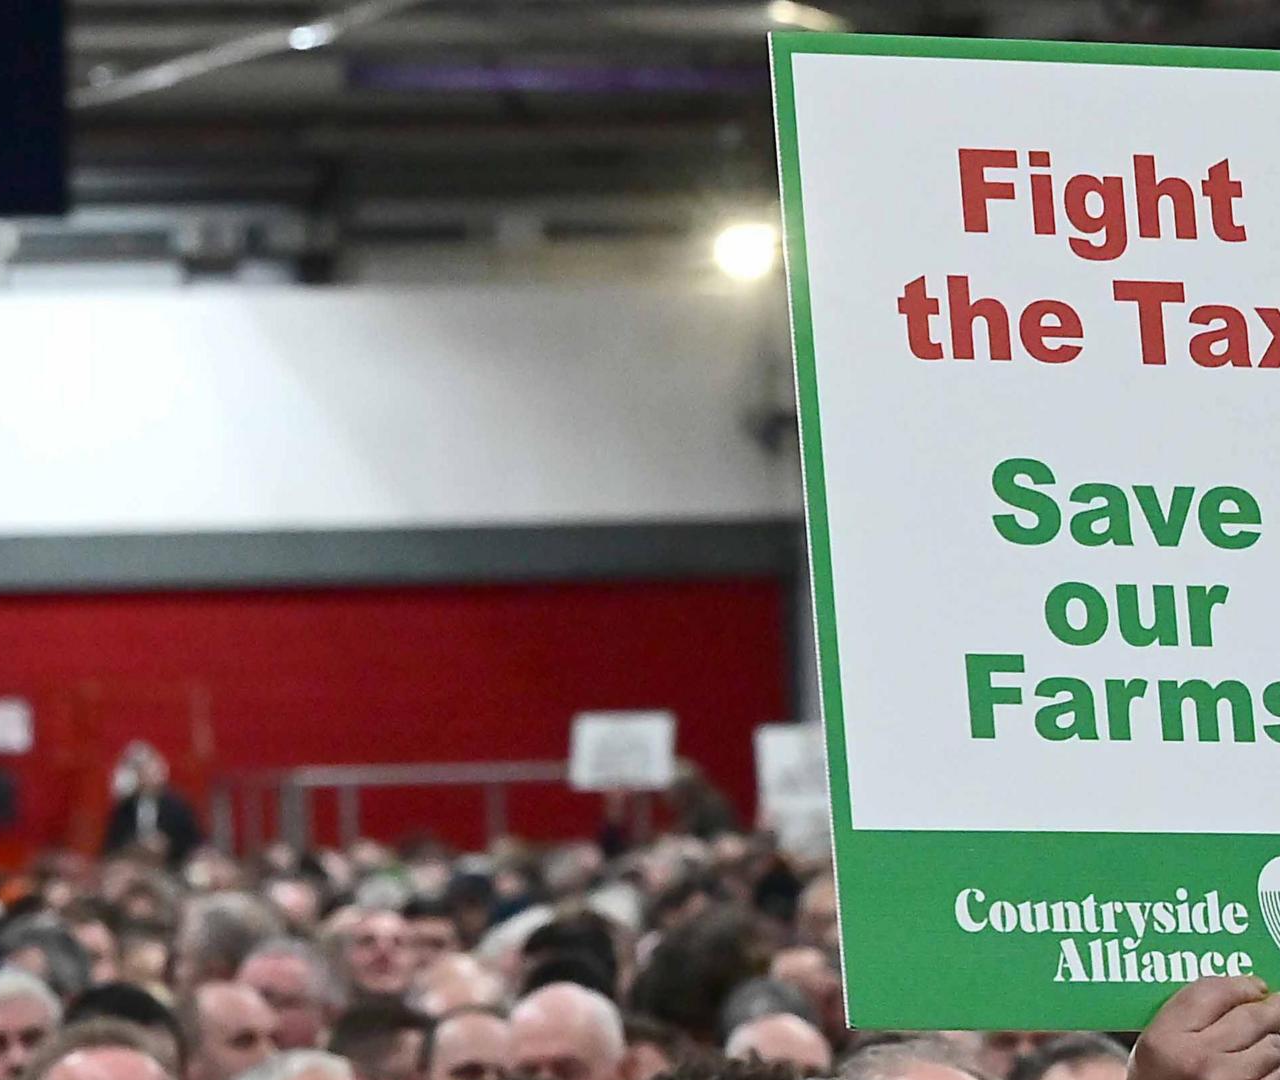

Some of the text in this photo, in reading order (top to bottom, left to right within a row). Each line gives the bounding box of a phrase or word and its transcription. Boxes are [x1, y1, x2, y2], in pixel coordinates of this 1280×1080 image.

[959, 149, 1246, 260] Fight
[898, 276, 1084, 364] the
[993, 459, 1261, 549] Save
[1046, 582, 1229, 648] our
[955, 887, 1249, 938] Countryside
[1053, 937, 1253, 983] Alliance
